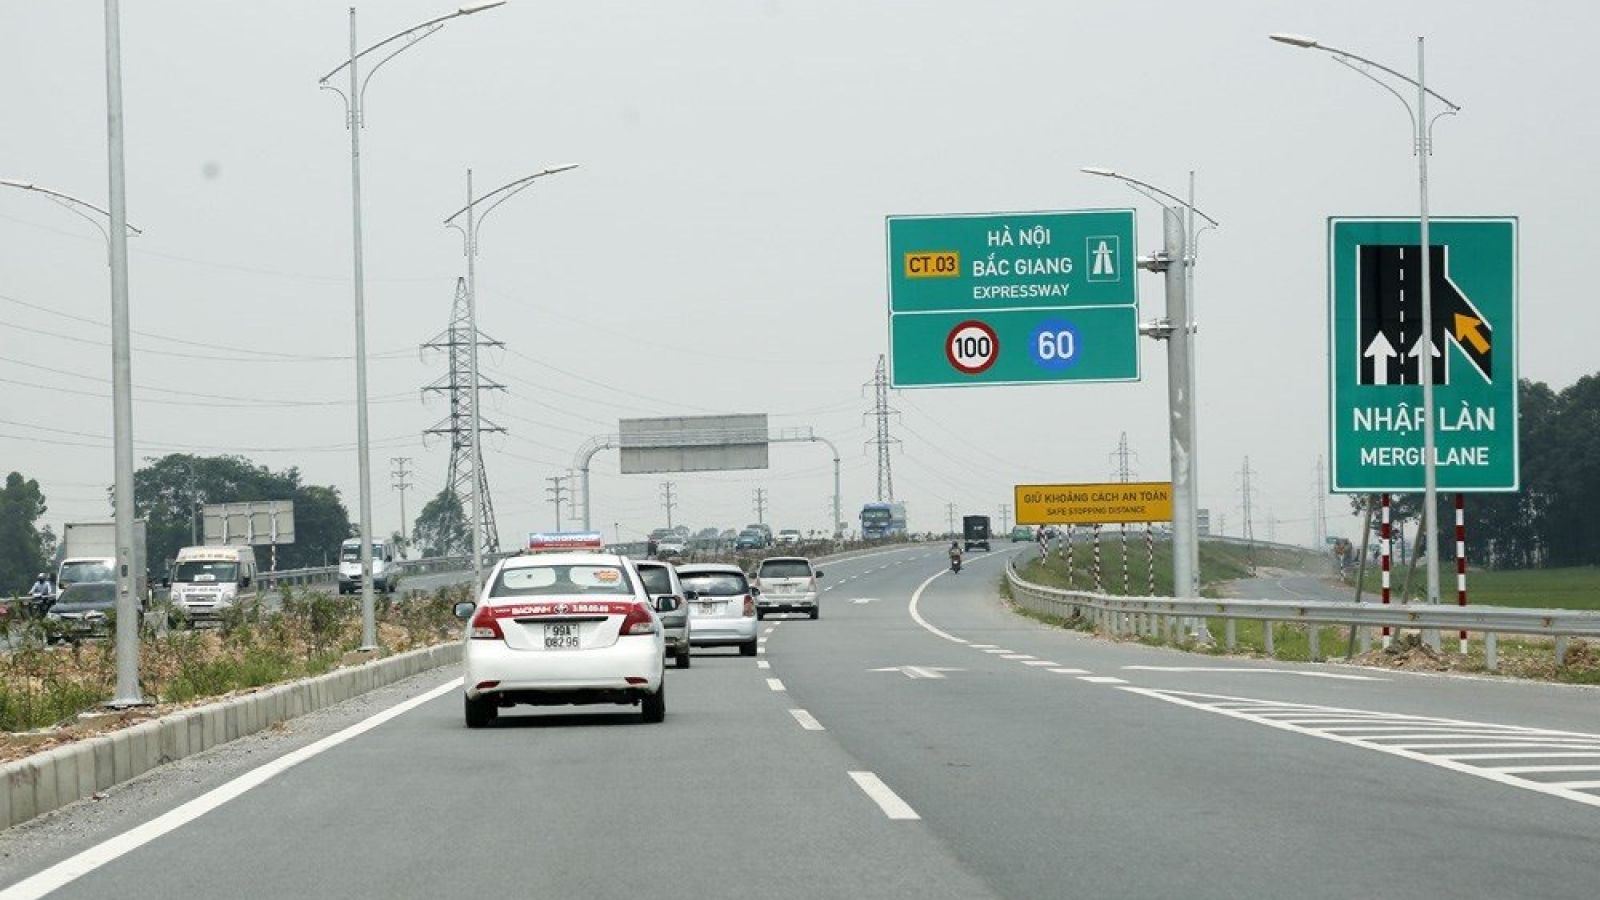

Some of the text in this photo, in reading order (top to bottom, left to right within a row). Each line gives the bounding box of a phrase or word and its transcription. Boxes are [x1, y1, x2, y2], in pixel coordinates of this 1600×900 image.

[988, 225, 1051, 248] HÀ NỘI
[909, 256, 956, 273] CT.03
[972, 251, 1073, 277] BẮC GIANG
[973, 283, 1070, 299] EXPRESSWAY
[955, 337, 991, 358] 100
[1038, 330, 1074, 360] 60
[1439, 400, 1495, 431] LÀN
[1433, 447, 1489, 466] LANE
[1122, 492, 1137, 501] AN
[1047, 507, 1066, 516] SAFE
